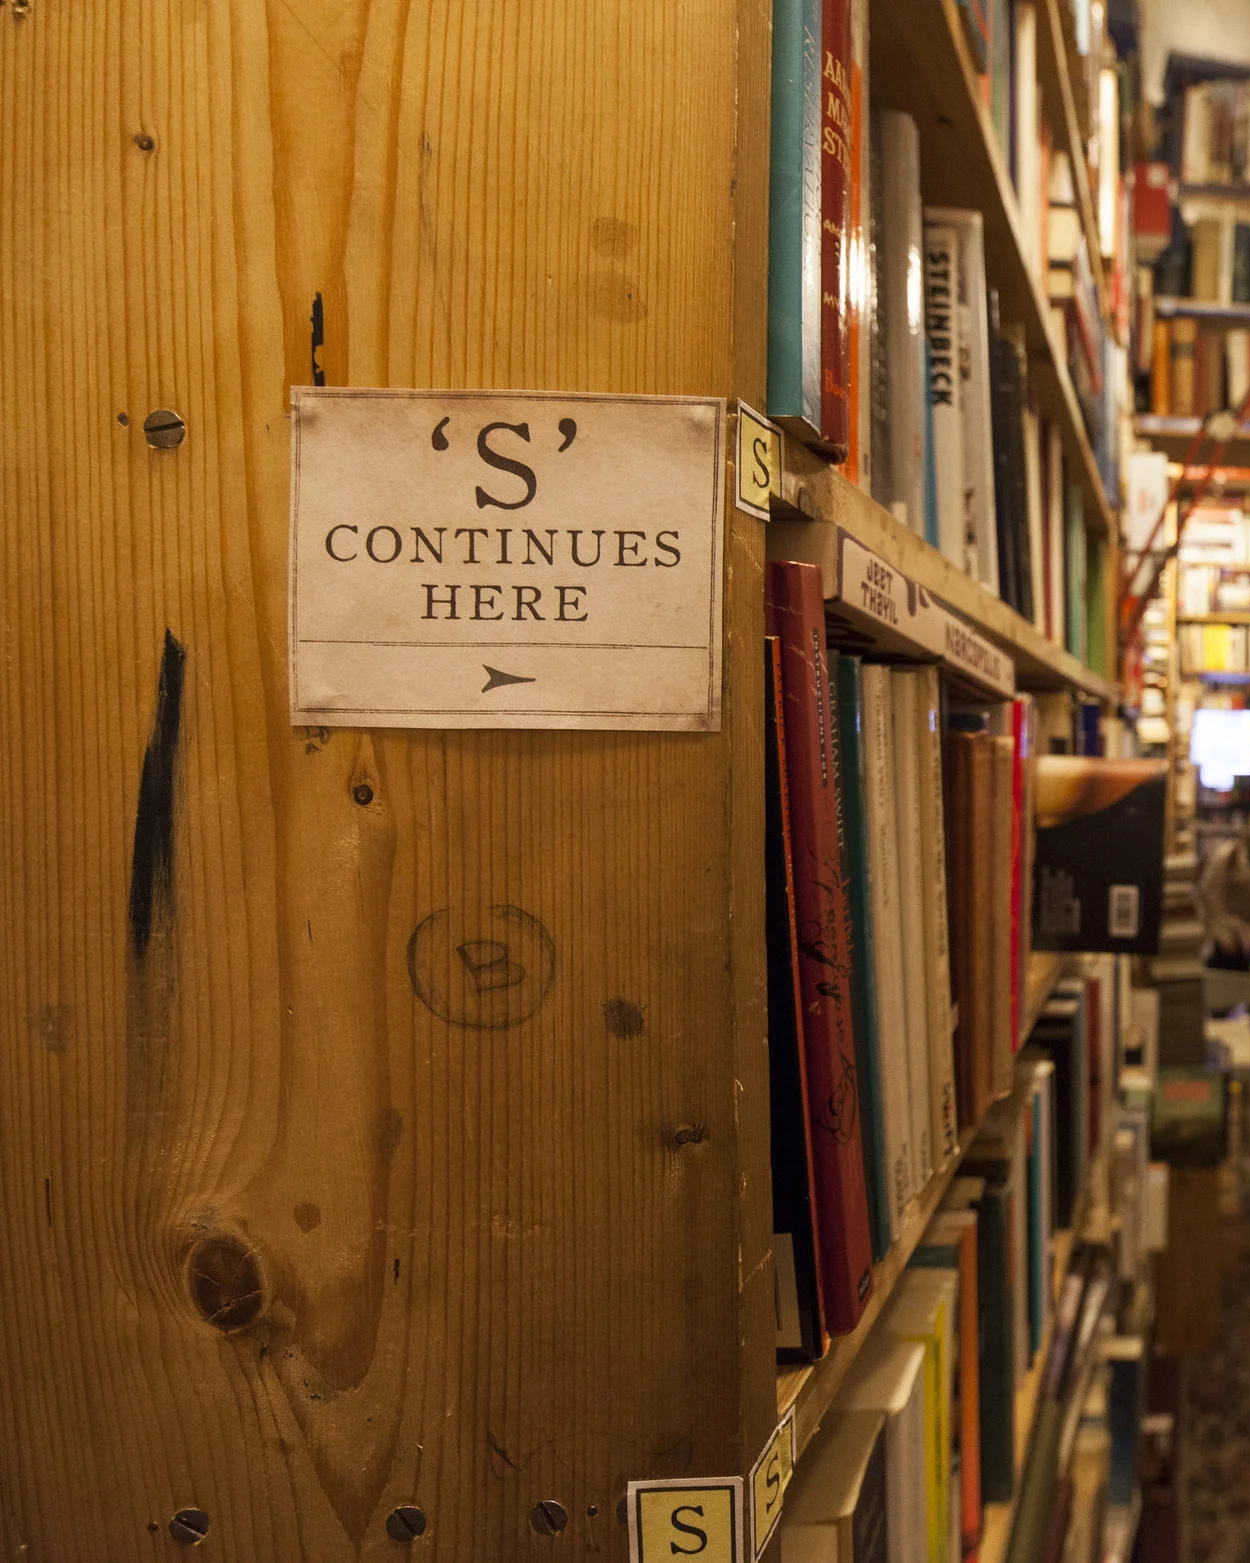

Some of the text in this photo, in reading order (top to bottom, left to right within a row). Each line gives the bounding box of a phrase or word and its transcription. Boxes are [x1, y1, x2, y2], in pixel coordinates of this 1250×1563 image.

[928, 252, 952, 405] STEINBECK
[431, 416, 577, 510] ‘S’
[753, 437, 770, 489] S
[325, 524, 681, 568] CONTINUES
[421, 584, 589, 622] HERE
[766, 1453, 780, 1514] S
[670, 1505, 708, 1555] S
